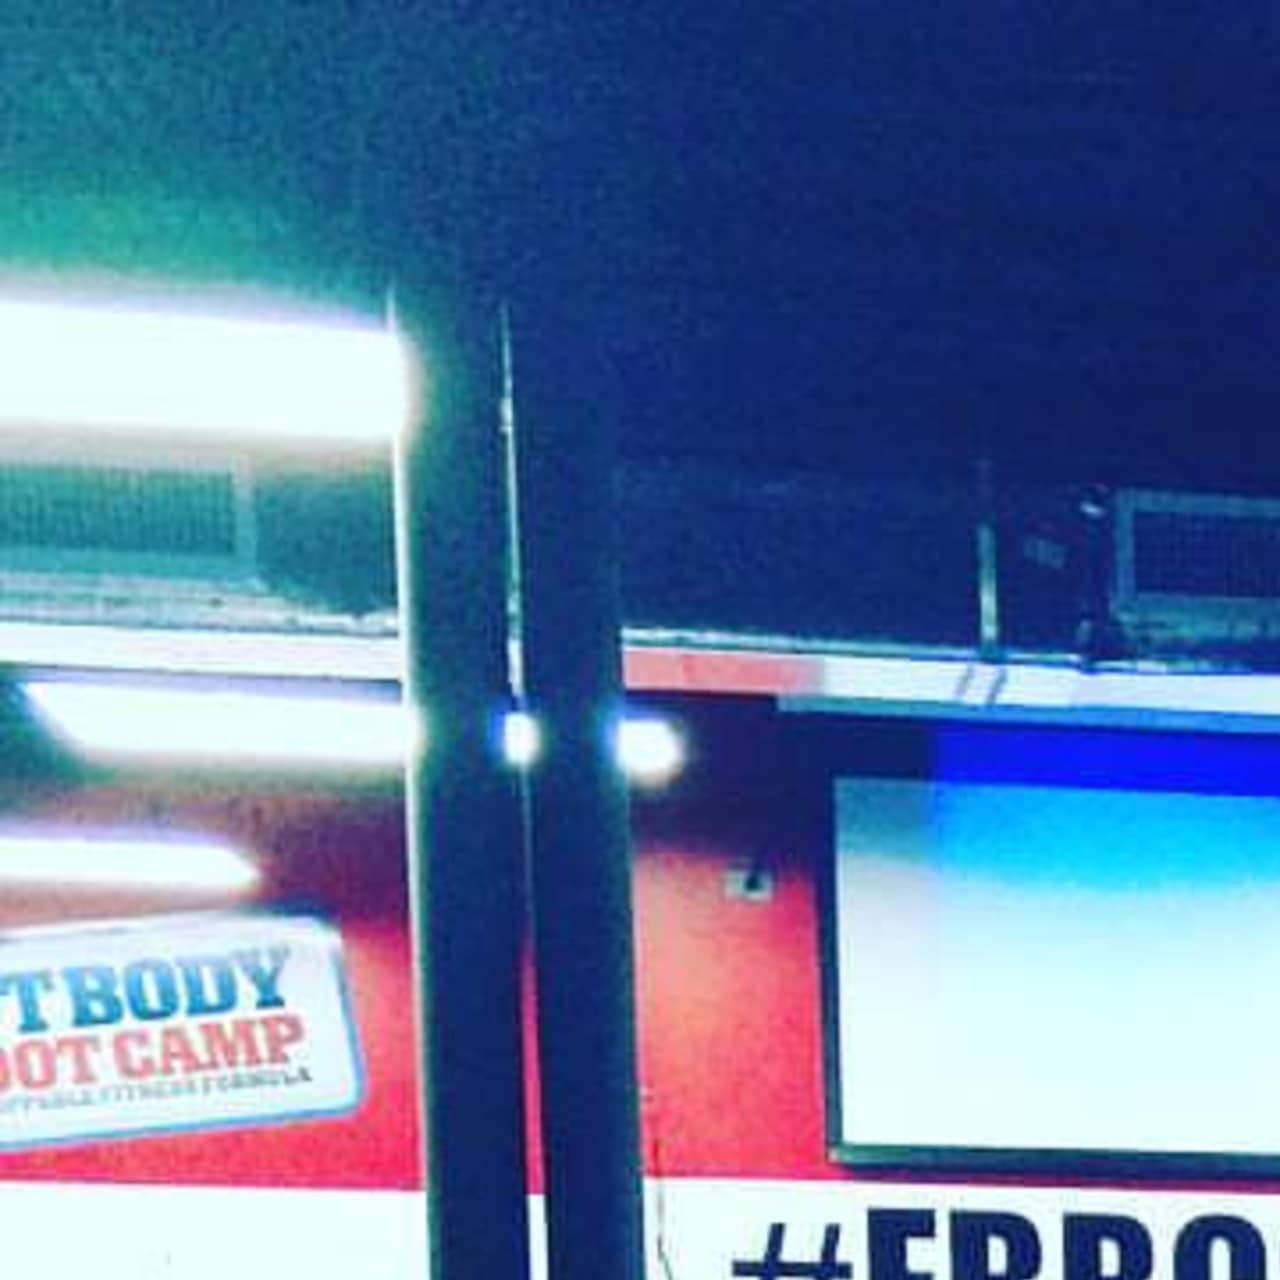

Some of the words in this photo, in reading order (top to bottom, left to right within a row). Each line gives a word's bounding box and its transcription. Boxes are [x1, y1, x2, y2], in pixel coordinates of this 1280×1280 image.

[62, 944, 290, 1027] BODY
[0, 1035, 100, 1094] OT
[113, 1013, 304, 1079] CAMP
